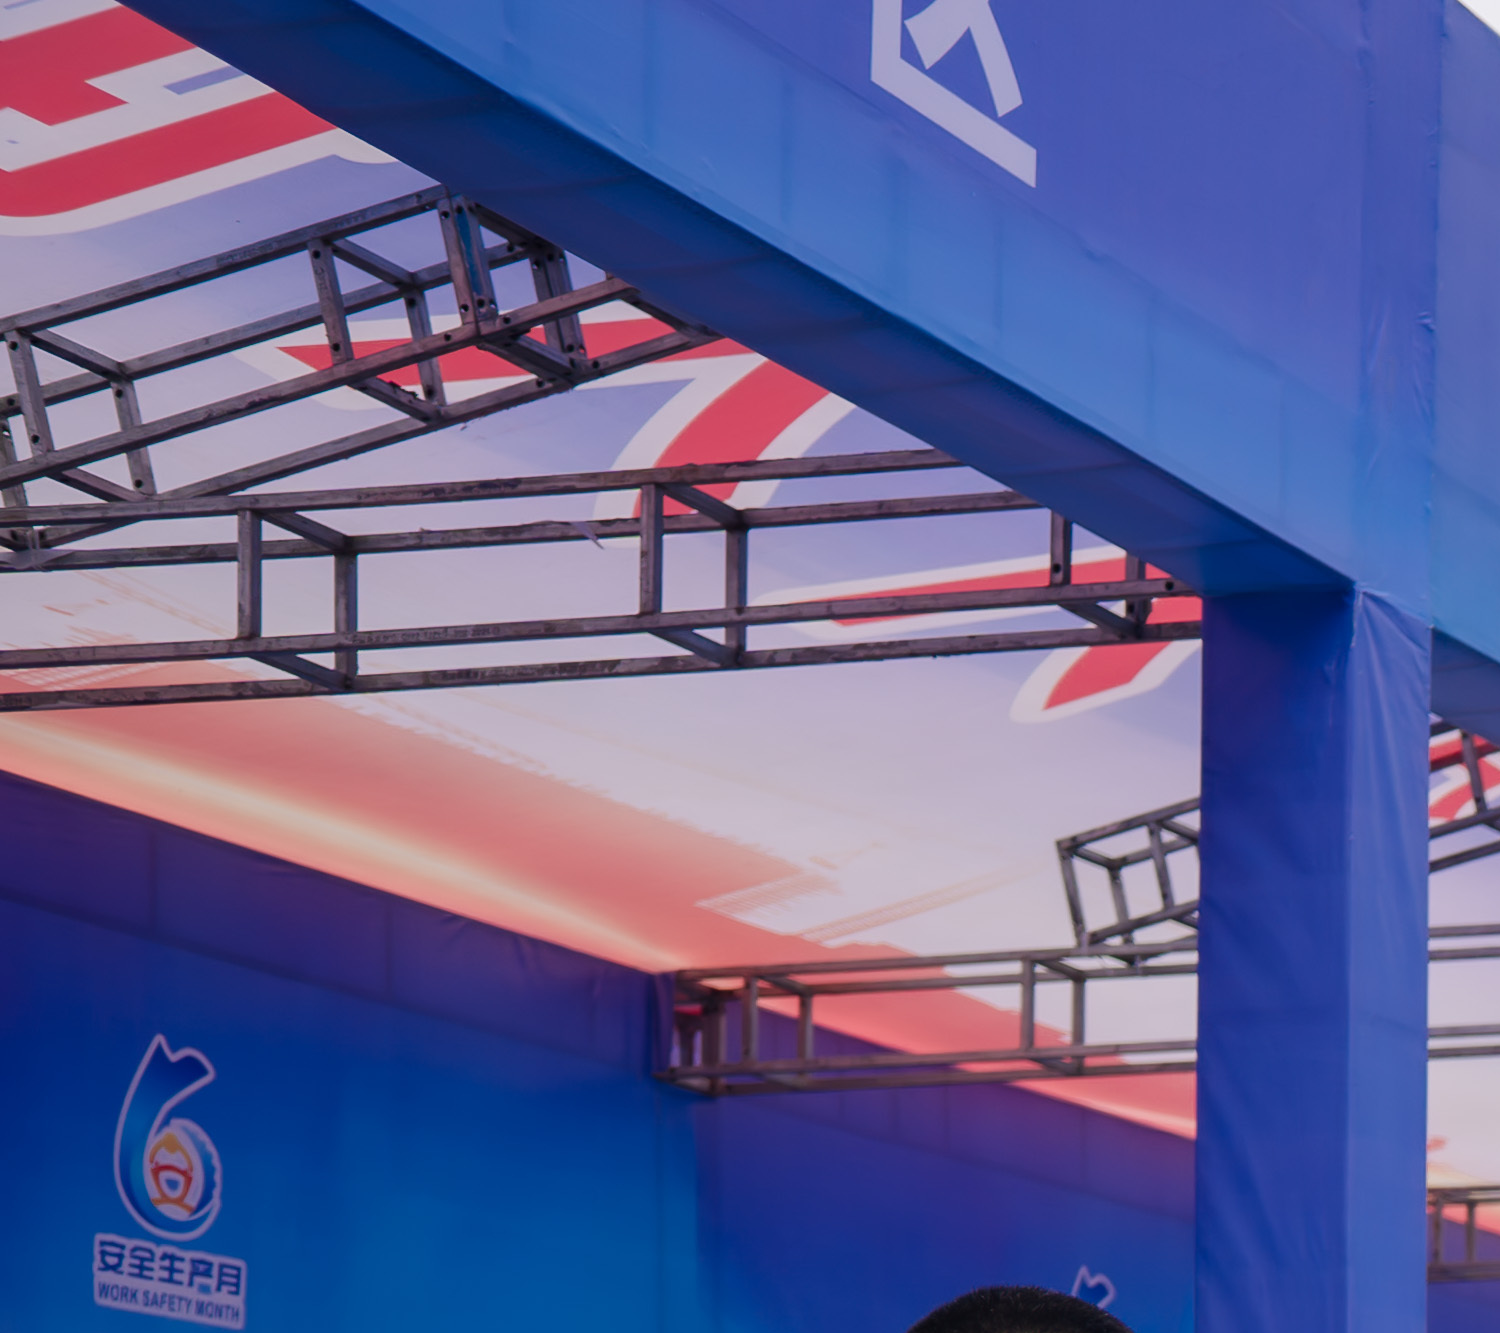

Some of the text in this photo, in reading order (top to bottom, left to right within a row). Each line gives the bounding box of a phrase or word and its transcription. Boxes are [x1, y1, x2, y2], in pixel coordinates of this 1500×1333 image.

[97, 1240, 242, 1296] 安全生产月
[98, 1282, 240, 1323] WORK SAFETY MONTH
